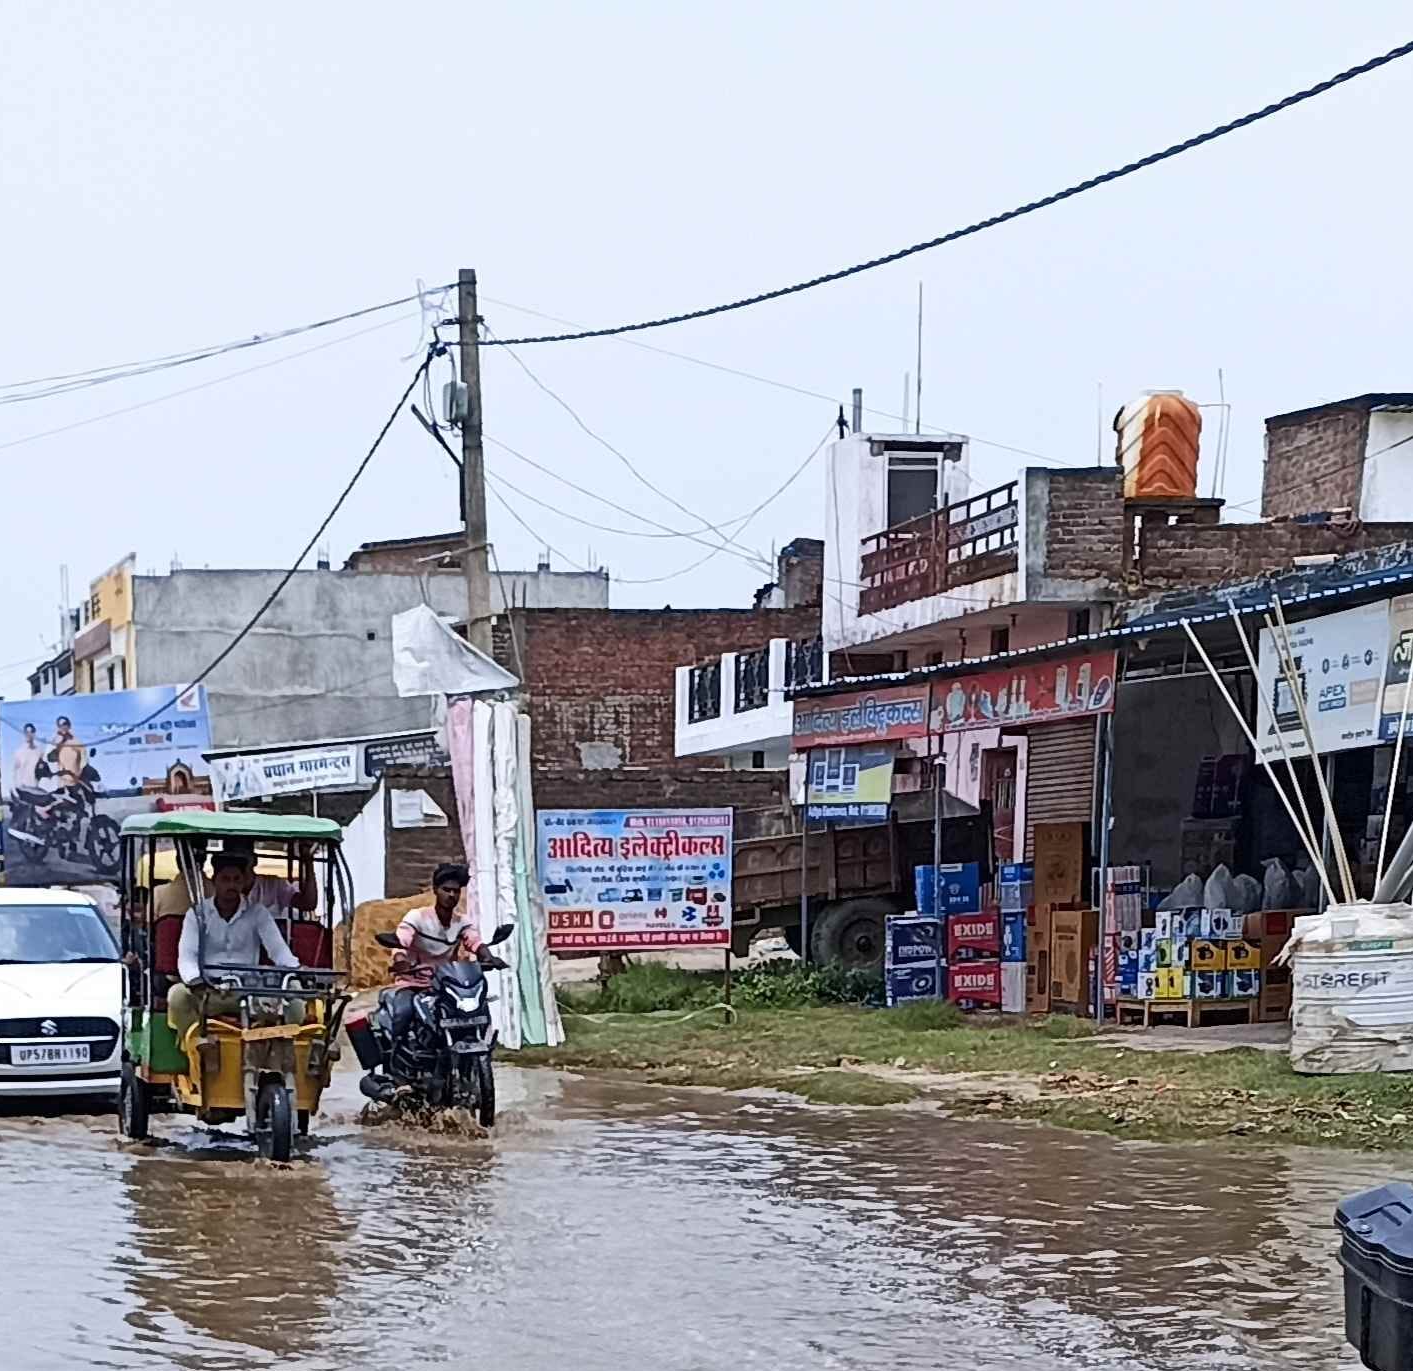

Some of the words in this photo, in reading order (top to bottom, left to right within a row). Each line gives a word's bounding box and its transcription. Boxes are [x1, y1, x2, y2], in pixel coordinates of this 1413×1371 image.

[547, 832, 613, 859] आदित्य
[550, 914, 592, 928] USHA
[954, 922, 994, 937] EXIDE
[954, 973, 995, 988] EXIDE
